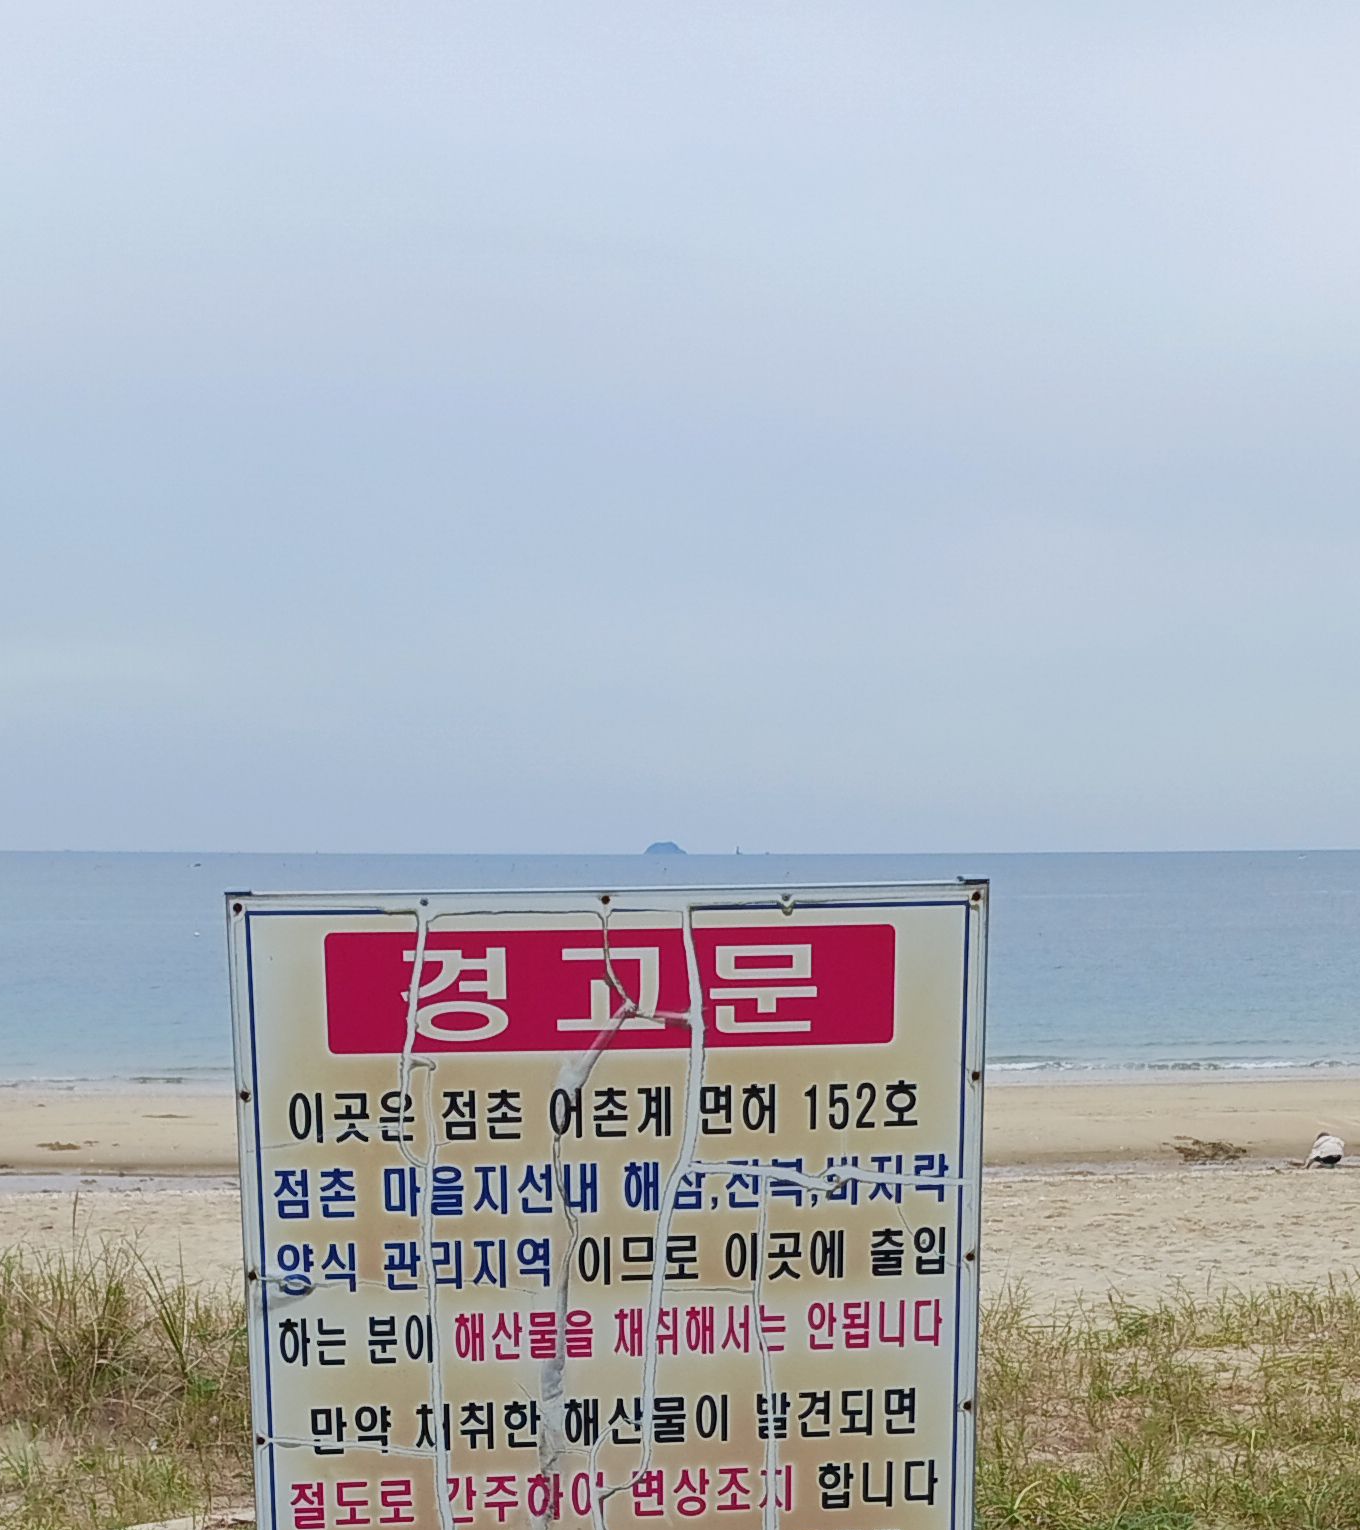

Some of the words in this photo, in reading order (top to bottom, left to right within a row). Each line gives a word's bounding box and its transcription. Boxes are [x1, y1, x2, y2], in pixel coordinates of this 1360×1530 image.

[289, 1090, 415, 1143] 이곳은
[441, 1089, 522, 1141] 점촌
[549, 1085, 671, 1138] 어촌계
[700, 1083, 775, 1135] 면허
[804, 1080, 918, 1130] 152호
[273, 1168, 356, 1219] 점촌
[383, 1163, 598, 1217] 마을지선내
[277, 1243, 357, 1296] 양식
[383, 1237, 550, 1291] 관리지역
[578, 1234, 699, 1285] 이므로
[725, 1229, 845, 1281] 이곳에
[870, 1226, 945, 1277] 출입
[279, 1316, 346, 1366] 하는
[368, 1314, 433, 1364] 분이
[454, 1309, 593, 1362] 해산물을
[614, 1304, 786, 1356] 채취해서는
[808, 1298, 943, 1350] 안됩니다
[310, 1405, 391, 1455] 만약
[415, 1400, 540, 1450] 채취한
[564, 1394, 728, 1446] 해산물이
[756, 1387, 916, 1439] 발견되면
[290, 1479, 415, 1530] 절도로
[818, 1459, 938, 1509] 합니다
